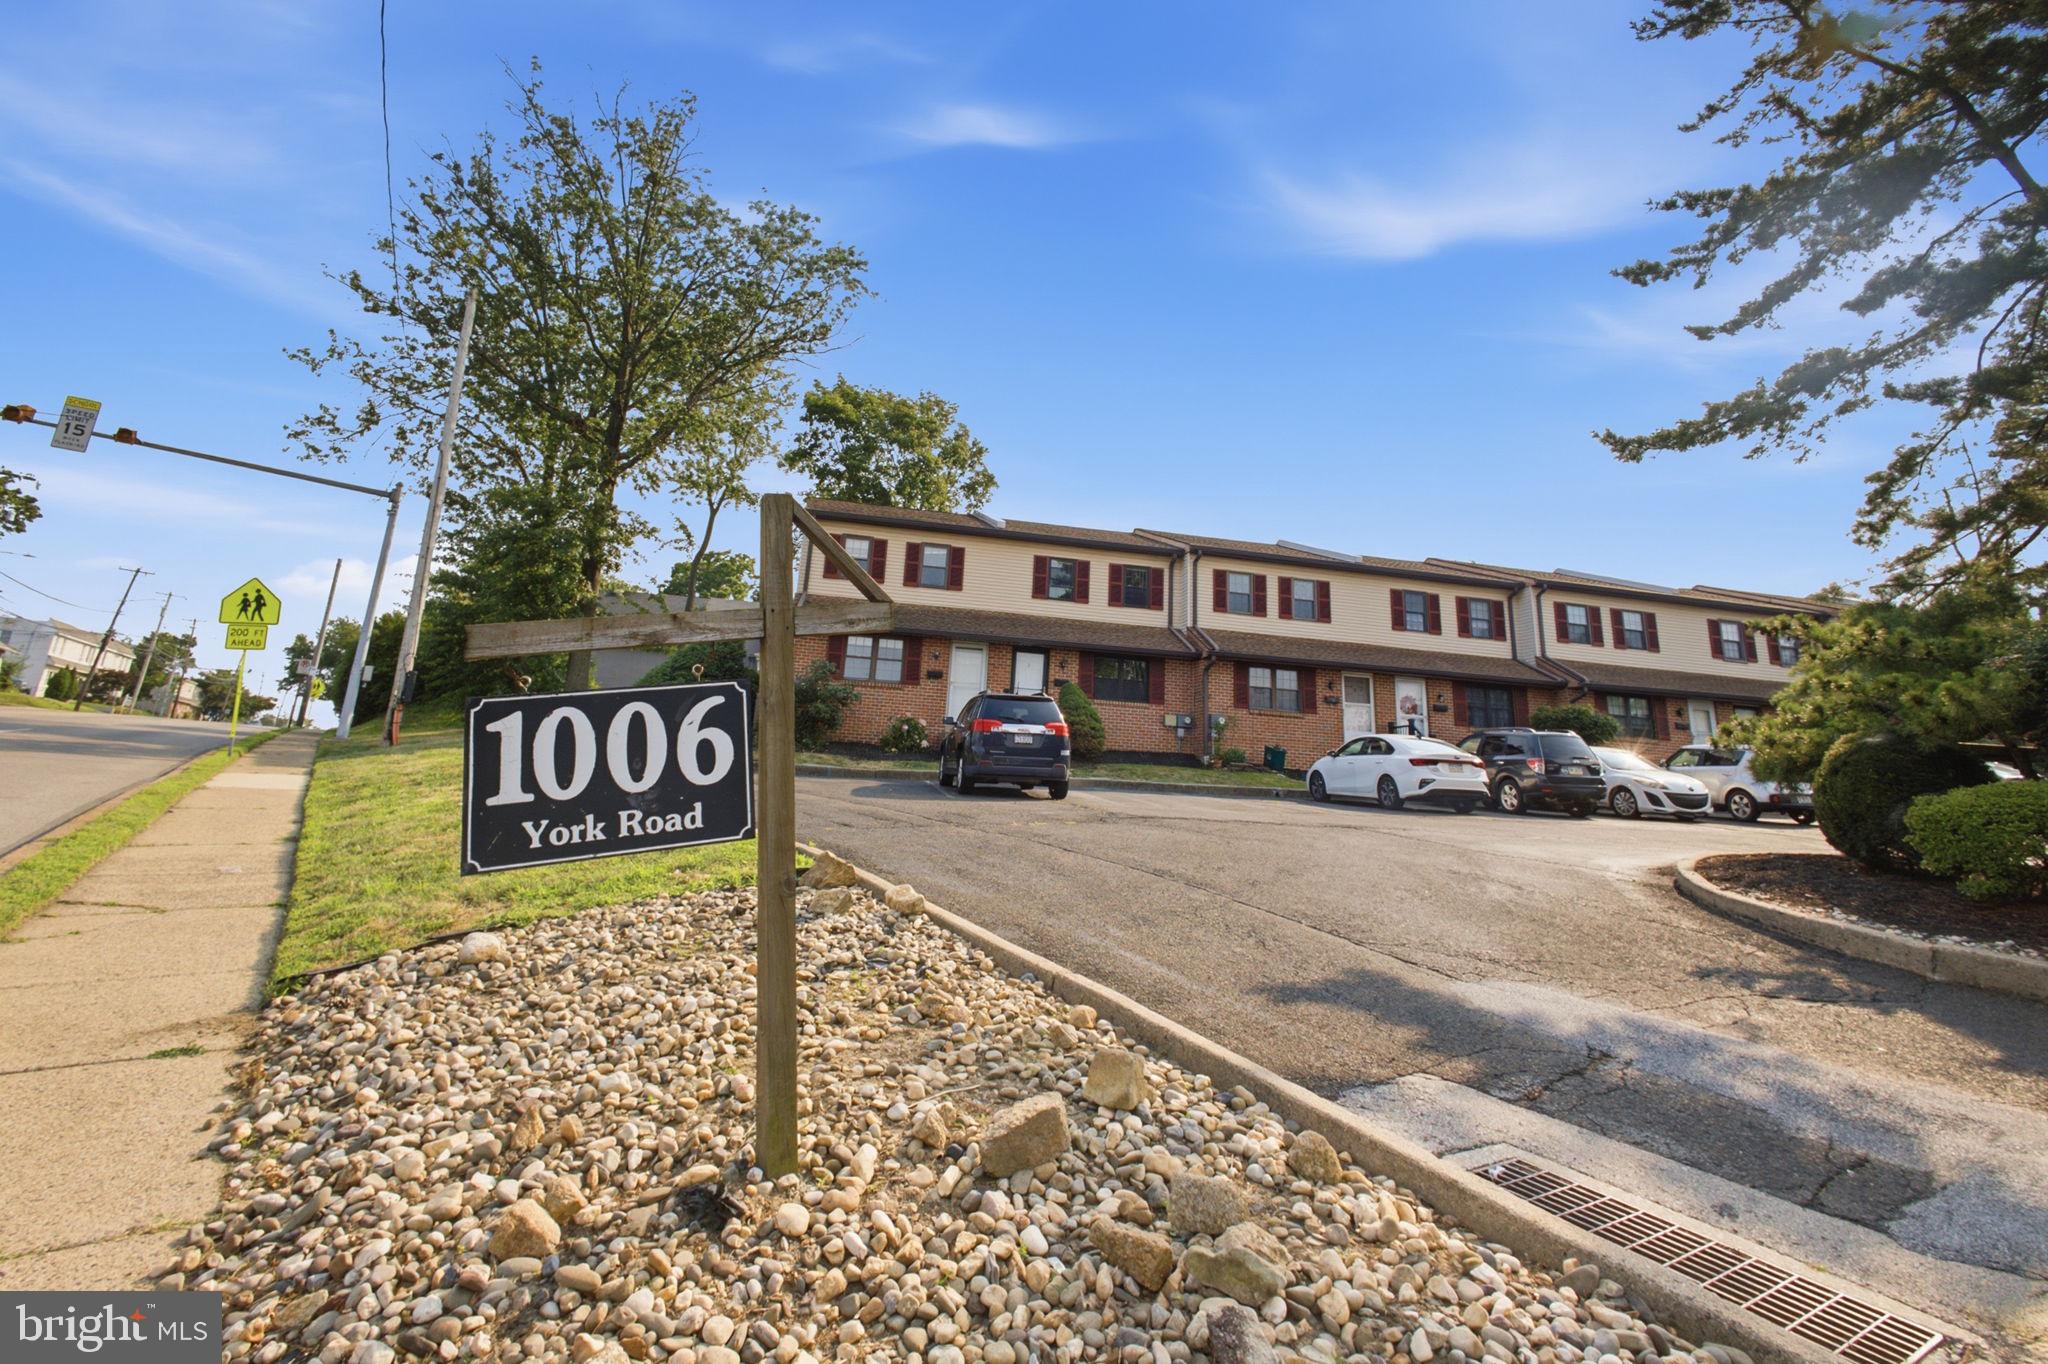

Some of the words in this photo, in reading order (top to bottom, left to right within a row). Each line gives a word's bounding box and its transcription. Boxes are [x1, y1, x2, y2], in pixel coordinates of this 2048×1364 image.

[65, 408, 95, 419] SPEED
[64, 422, 86, 436] 15
[230, 628, 249, 637] 200
[254, 629, 264, 637] FT
[230, 639, 262, 647] AHEAD
[485, 695, 735, 807] 1006
[521, 814, 607, 850] York
[618, 802, 704, 838] Road
